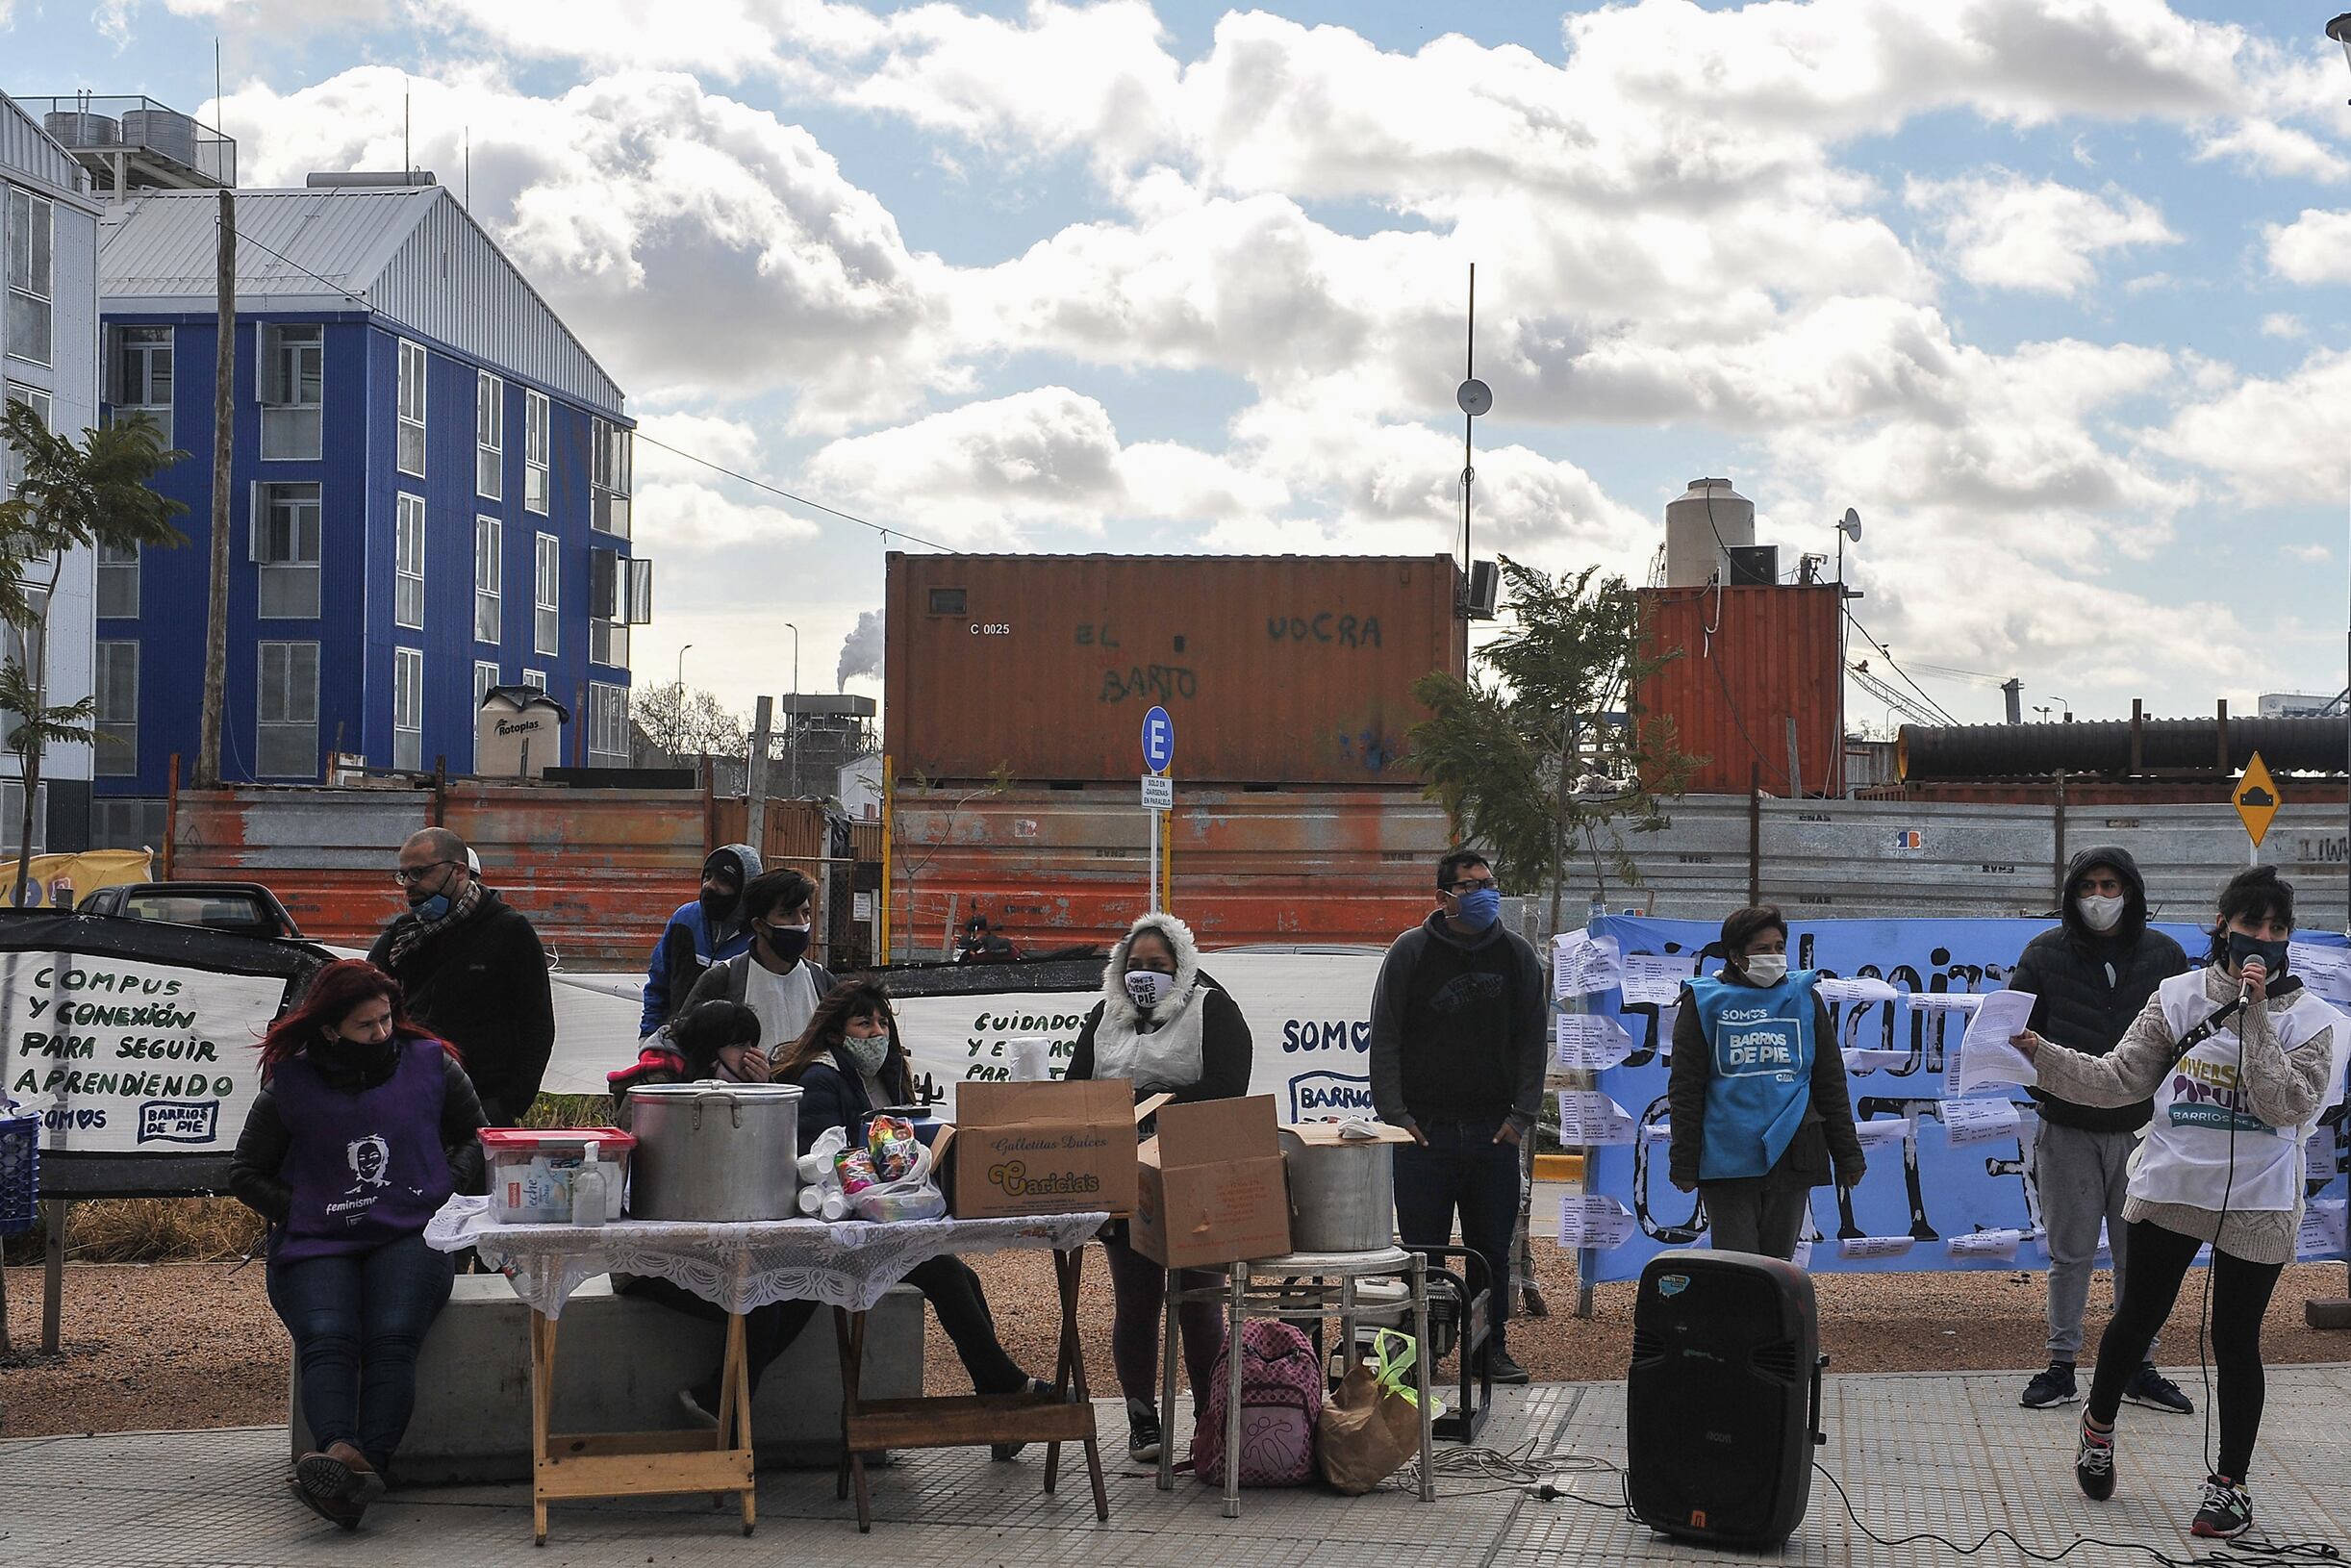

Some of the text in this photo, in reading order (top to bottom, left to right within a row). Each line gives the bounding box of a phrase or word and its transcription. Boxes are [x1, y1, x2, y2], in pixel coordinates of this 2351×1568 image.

[970, 624, 1010, 635] C 0025
[1267, 612, 1382, 648] UOCRA
[1100, 664, 1197, 704] BARTO
[499, 721, 539, 737] Rotoplas
[1150, 720, 1166, 760] E
[35, 968, 182, 996] COMPUS
[29, 997, 49, 1018] Y
[1137, 993, 1156, 1004] PIE
[19, 1032, 96, 1059] PARA
[968, 1038, 983, 1057] Y
[1730, 1031, 1787, 1048] BARRIOS
[1730, 1045, 1791, 1066] DE PIE
[147, 1108, 209, 1123] BARRIOS
[2173, 1111, 2230, 1123] BARRIOS
[145, 1121, 204, 1134] DE PIE
[991, 1134, 1108, 1155] Galletitas Dulces
